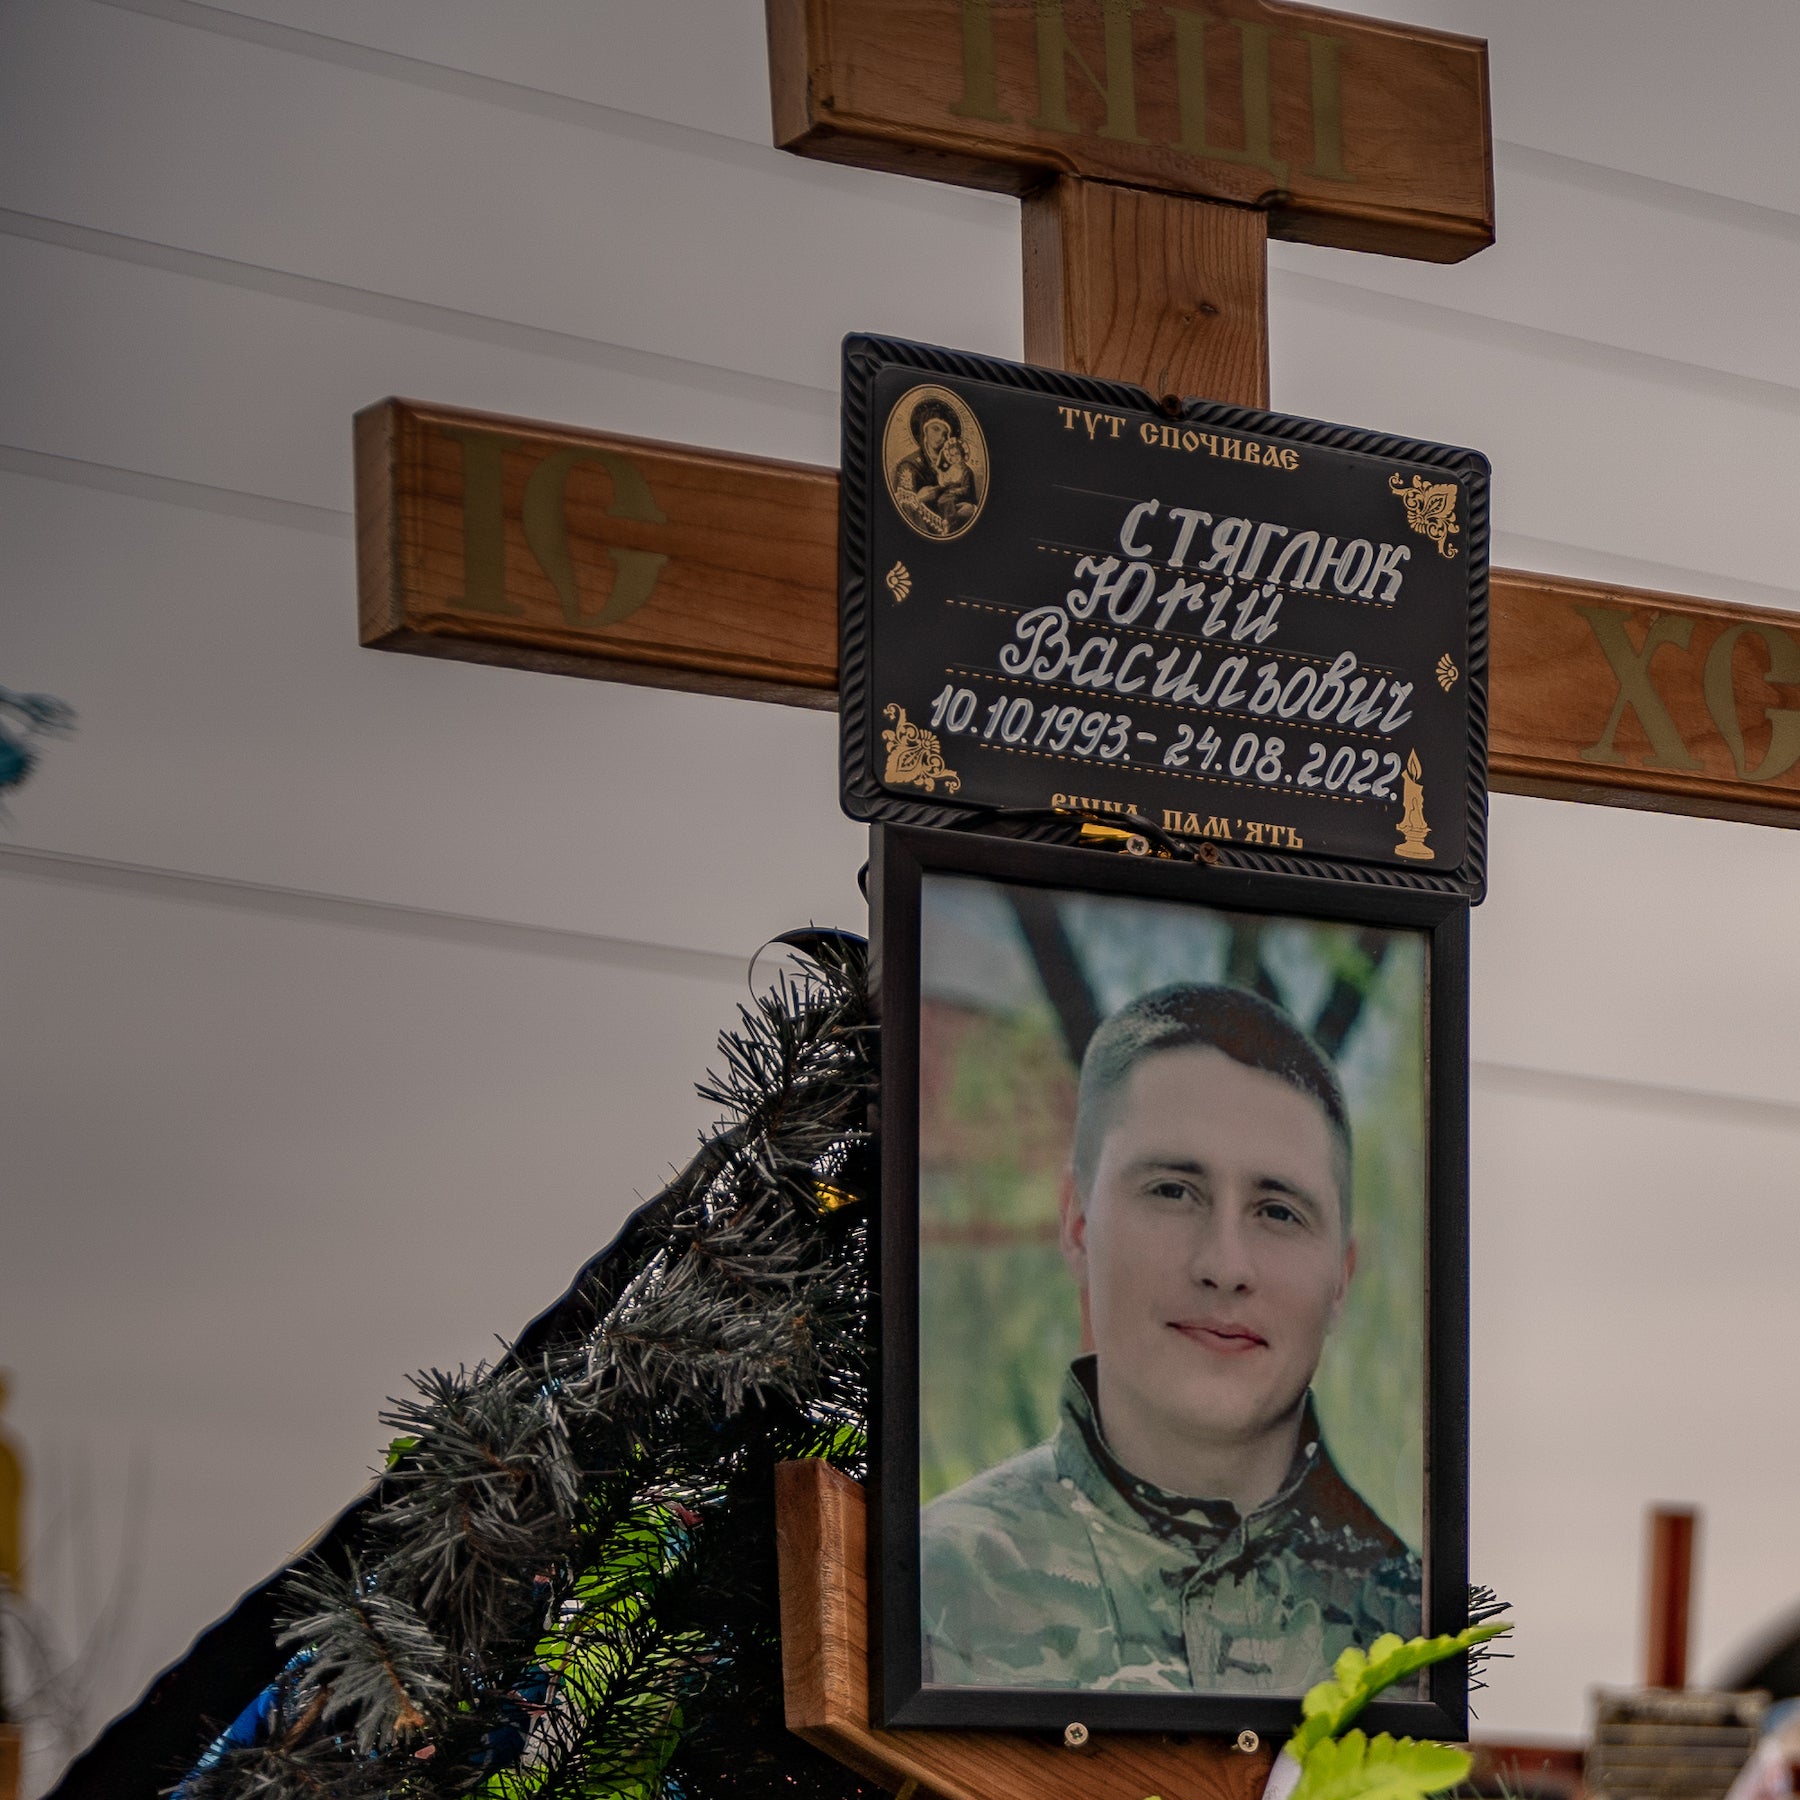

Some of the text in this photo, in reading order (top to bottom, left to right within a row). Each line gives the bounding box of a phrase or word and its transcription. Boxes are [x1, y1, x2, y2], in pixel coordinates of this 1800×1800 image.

[1058, 405, 1300, 470] ТУТ СПОЧИВАЄ
[1119, 498, 1412, 602] СТЯГЛЮК
[1066, 555, 1285, 645] Юрій
[999, 604, 1414, 733] Васильович
[1162, 808, 1305, 850] ПАМ'ЯТЬ
